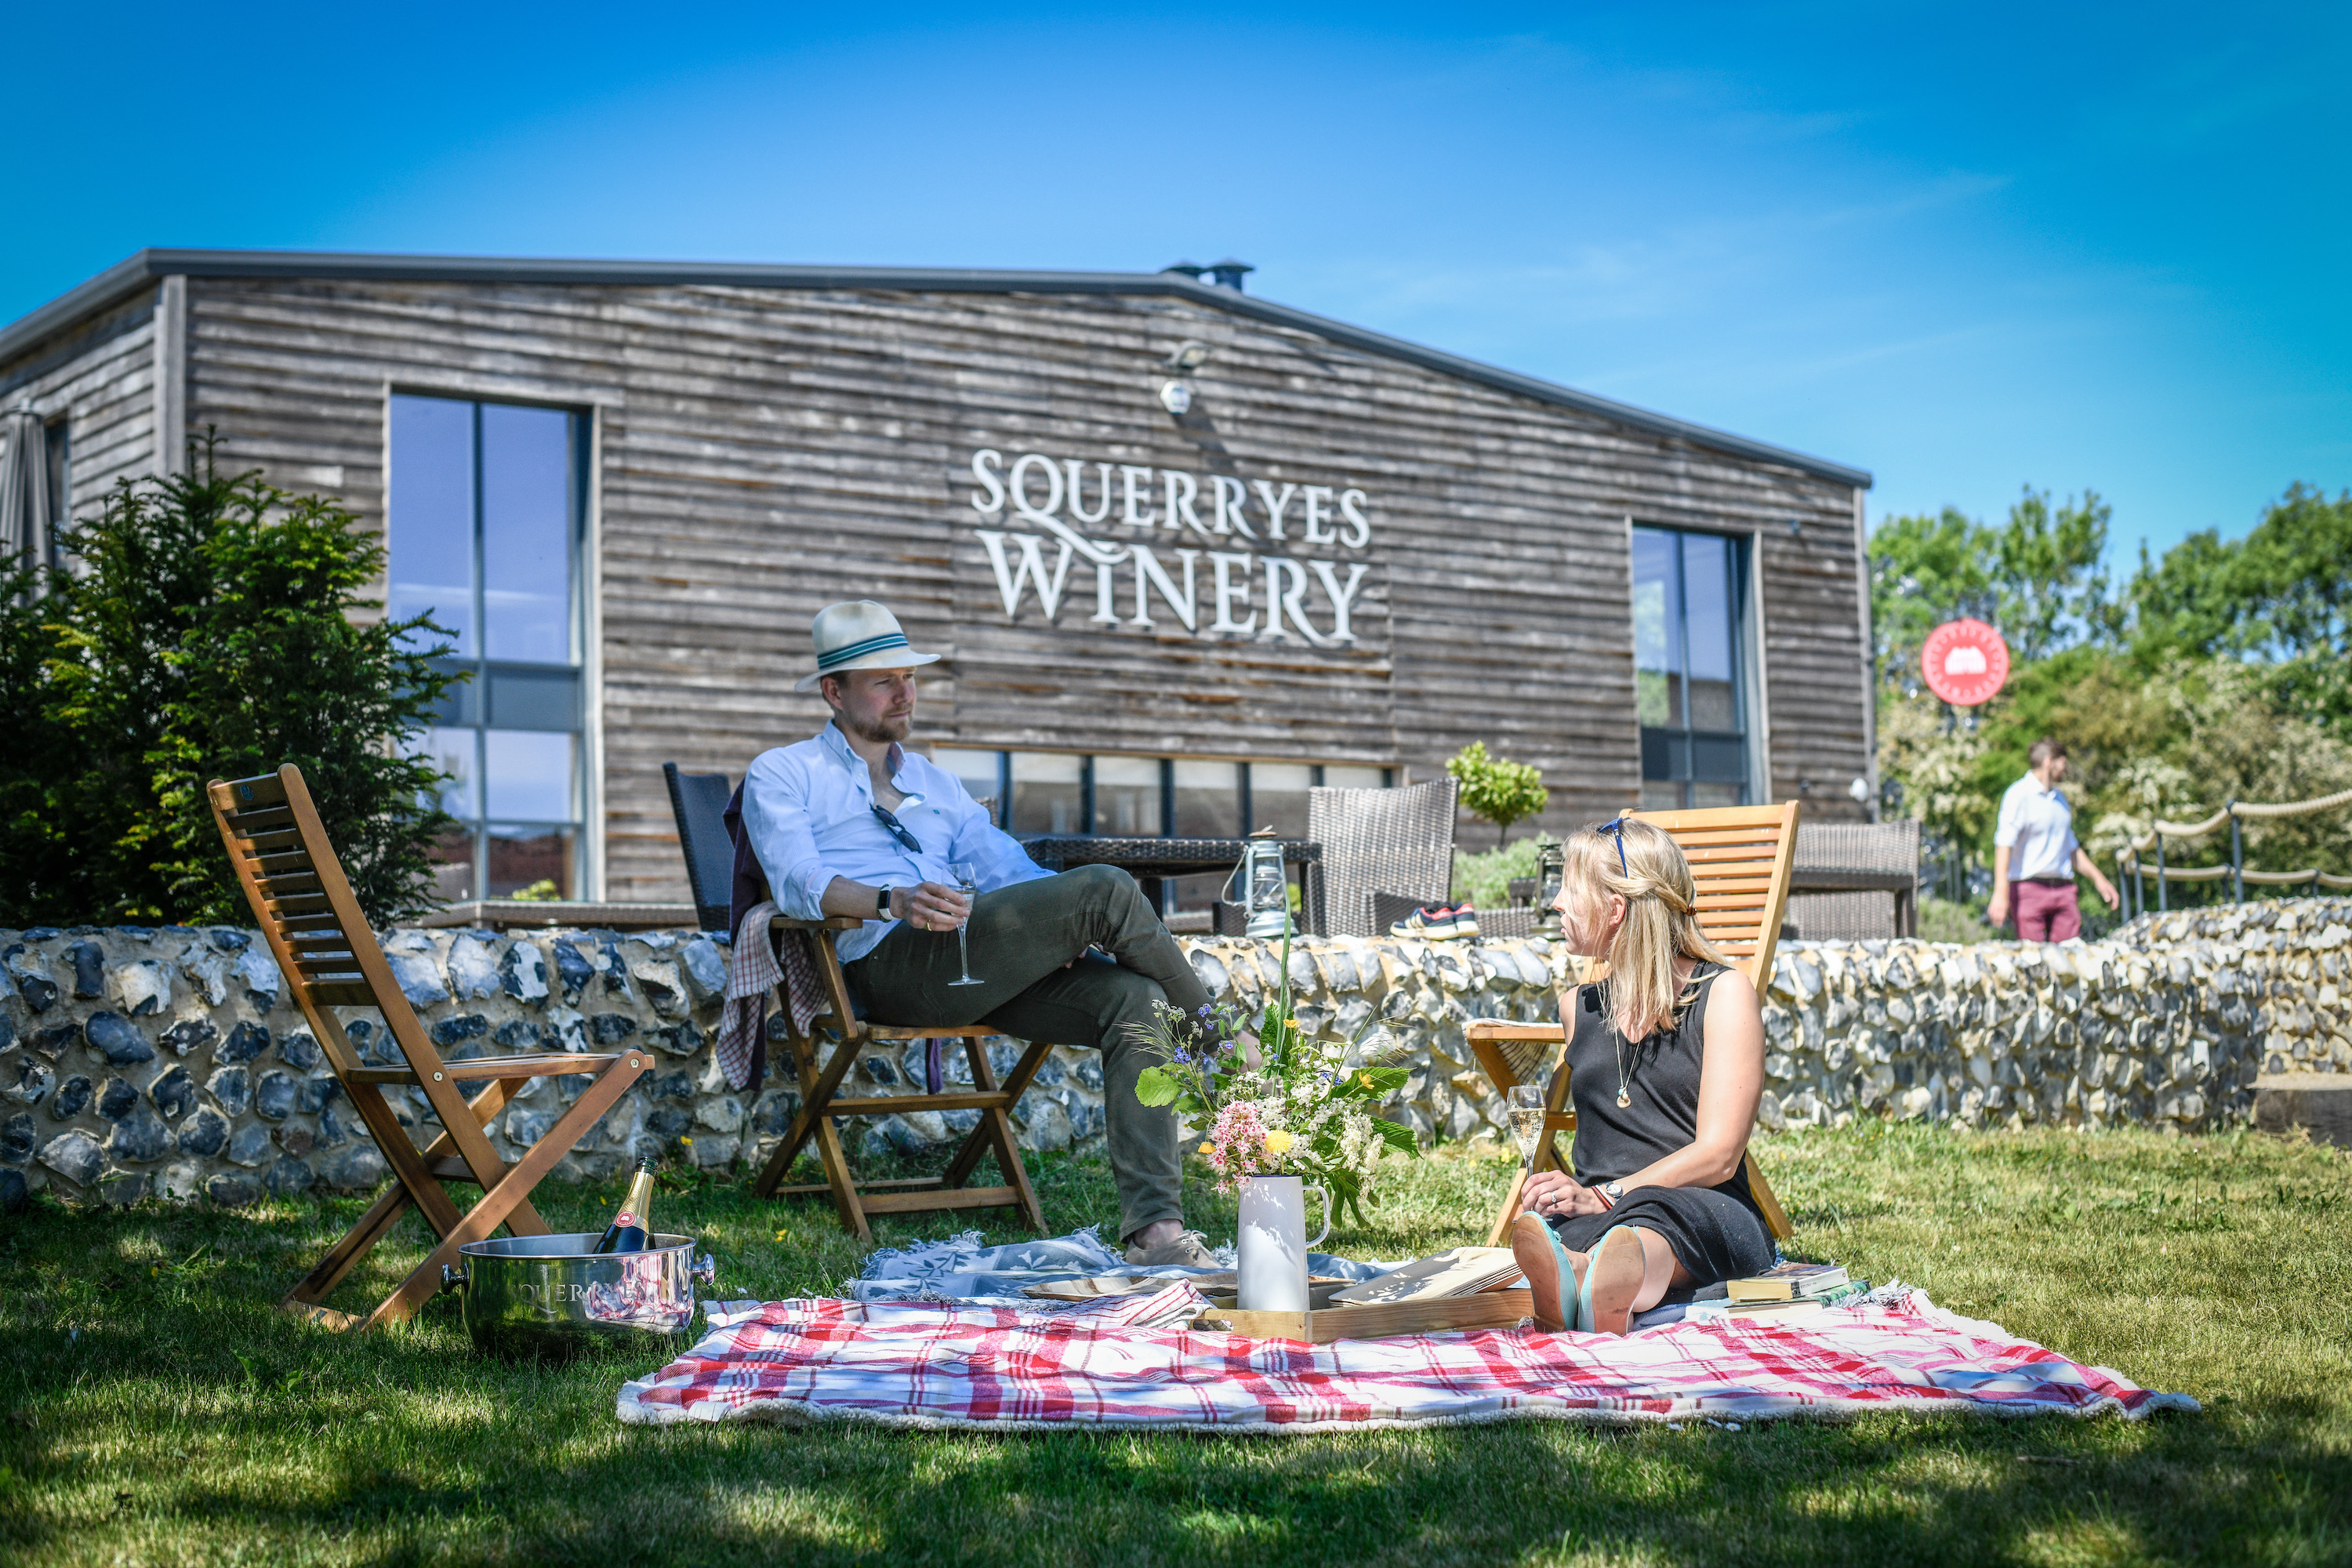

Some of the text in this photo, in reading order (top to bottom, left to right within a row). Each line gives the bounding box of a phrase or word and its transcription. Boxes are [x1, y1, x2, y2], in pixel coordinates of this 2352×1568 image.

[971, 448, 1370, 564] SQUERRYES
[975, 529, 1370, 647] WINERY
[510, 1282, 645, 1314] SQUERRYES
